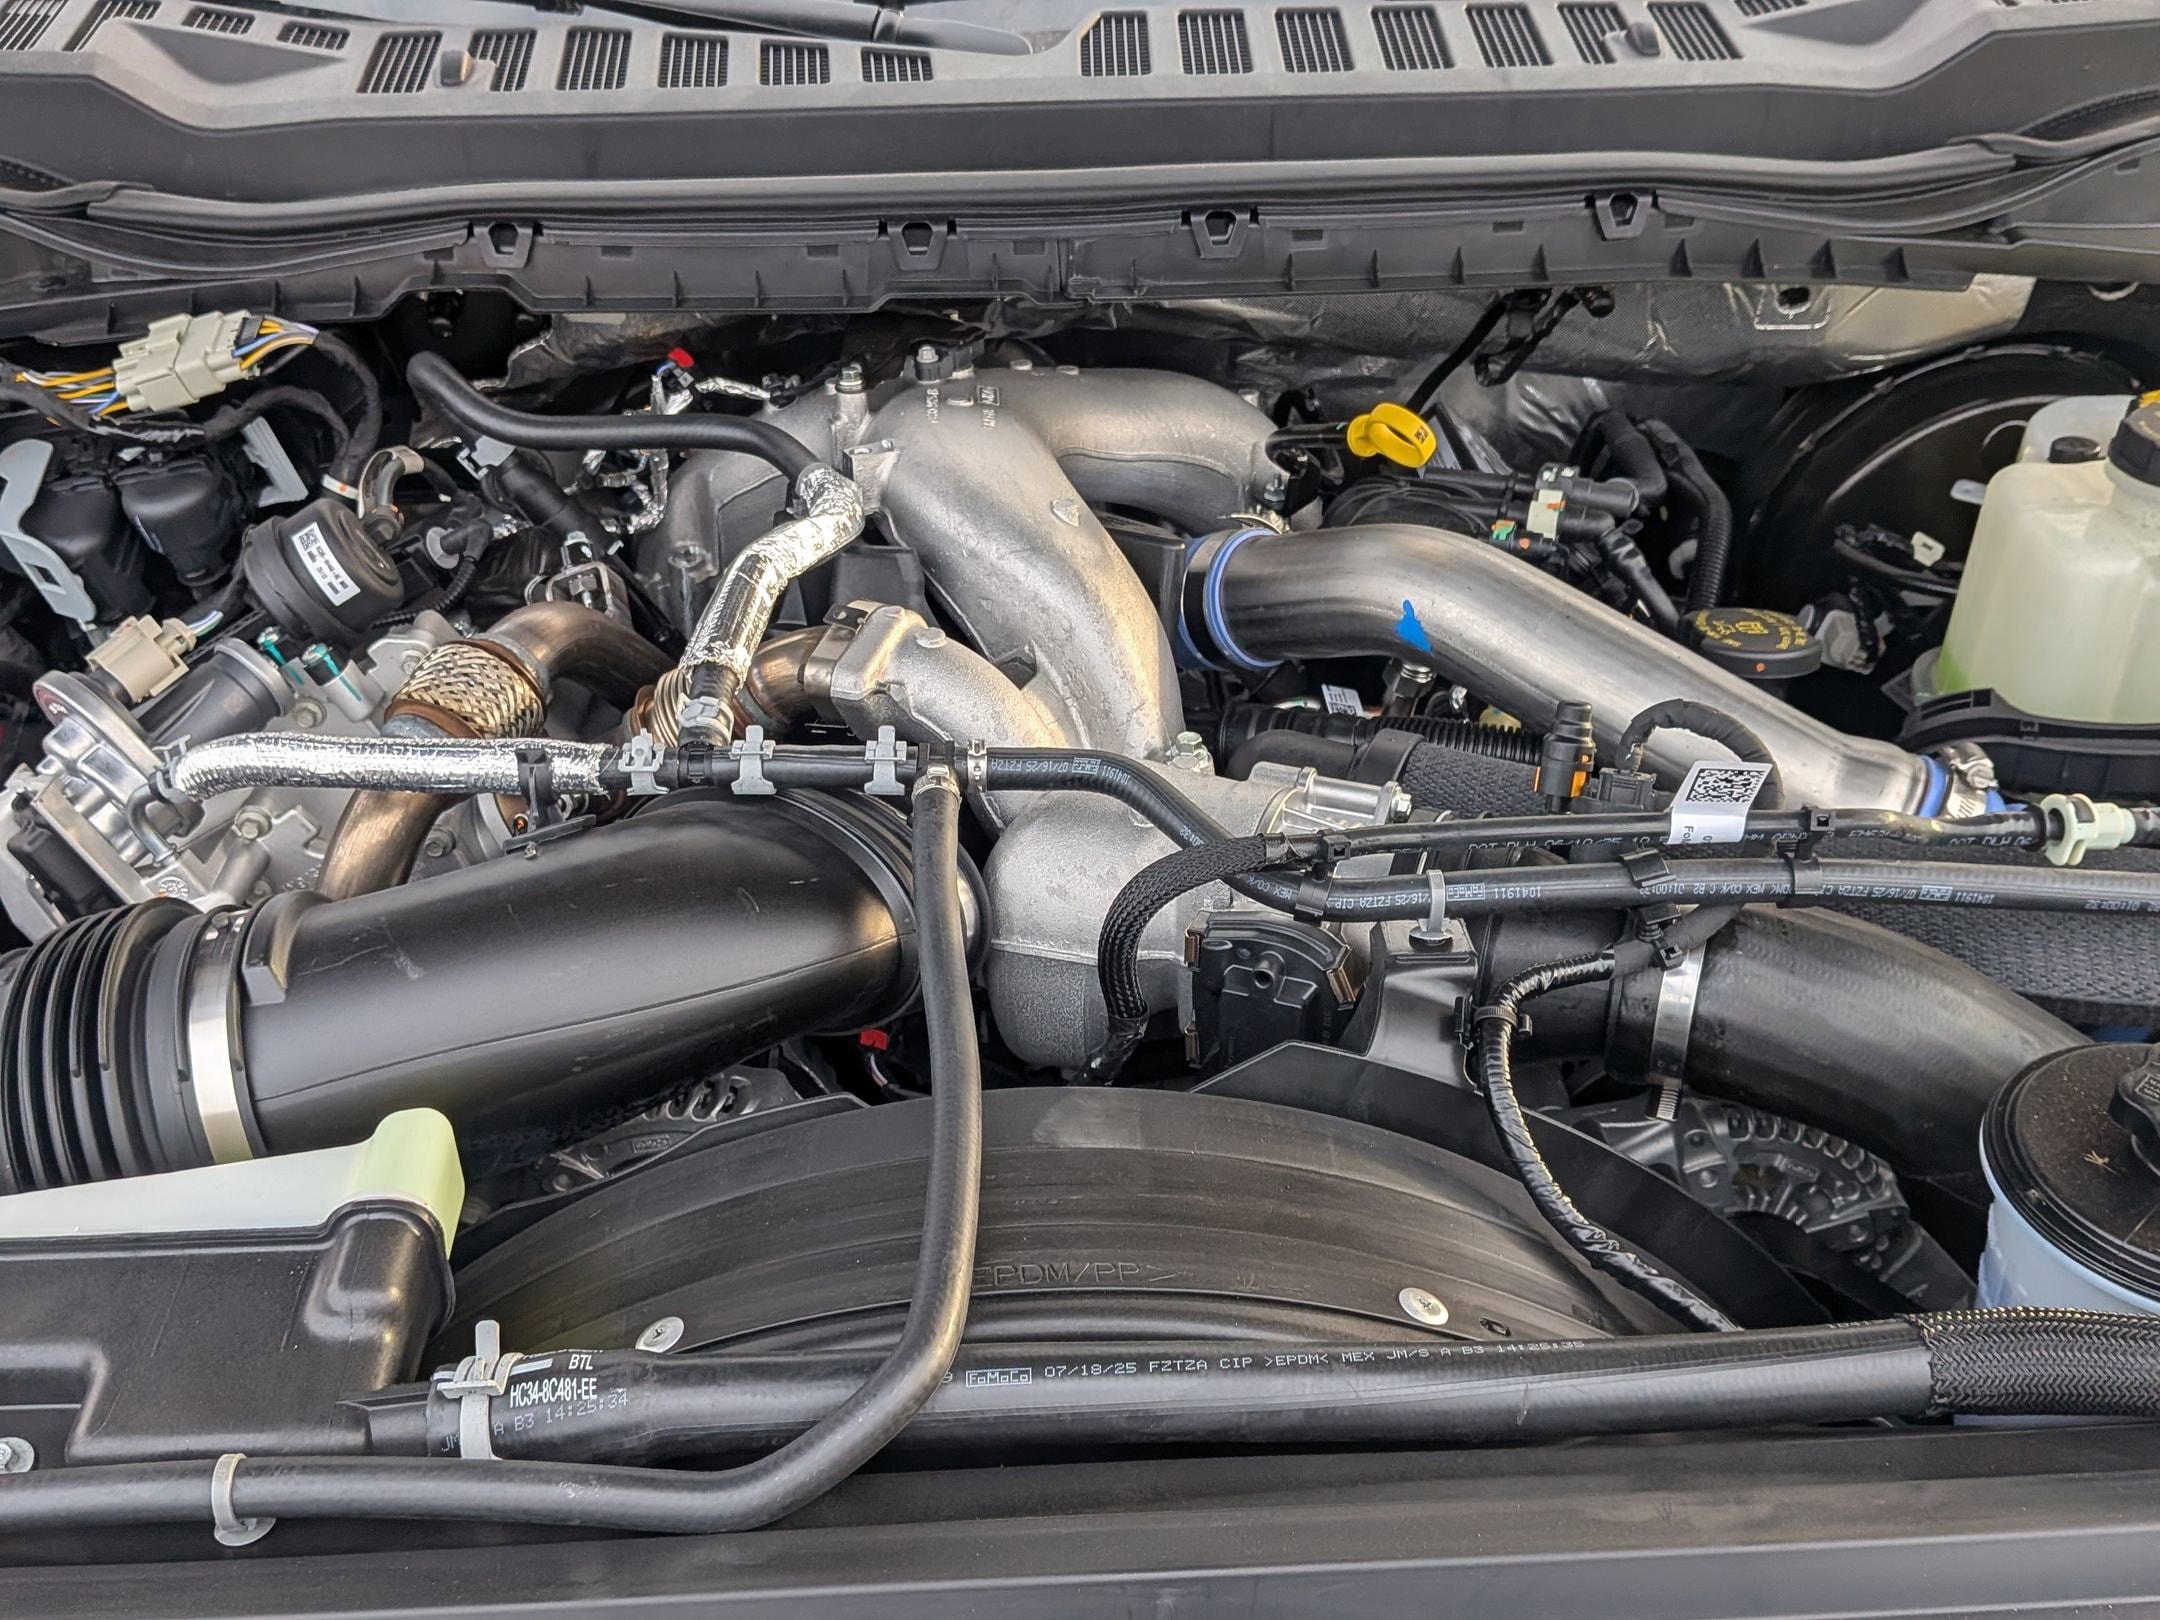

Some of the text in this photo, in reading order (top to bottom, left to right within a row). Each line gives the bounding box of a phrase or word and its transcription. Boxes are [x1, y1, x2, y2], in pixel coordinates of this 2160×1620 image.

[1494, 885, 1542, 899] 1041911
[568, 1354, 594, 1371] BTL
[966, 1367, 1033, 1388] FoMoCo
[1044, 1360, 1138, 1378] 07/18/25
[1148, 1358, 1208, 1373] FZTZA
[1220, 1356, 1253, 1369] CIP
[1264, 1353, 1329, 1367] >EPDM<
[1342, 1351, 1375, 1363] MEX
[1386, 1348, 1430, 1360] JM/S
[509, 1377, 598, 1409] HC34-8C481-EE
[514, 1412, 535, 1431] B3
[546, 1391, 629, 1424] 14:25:34
